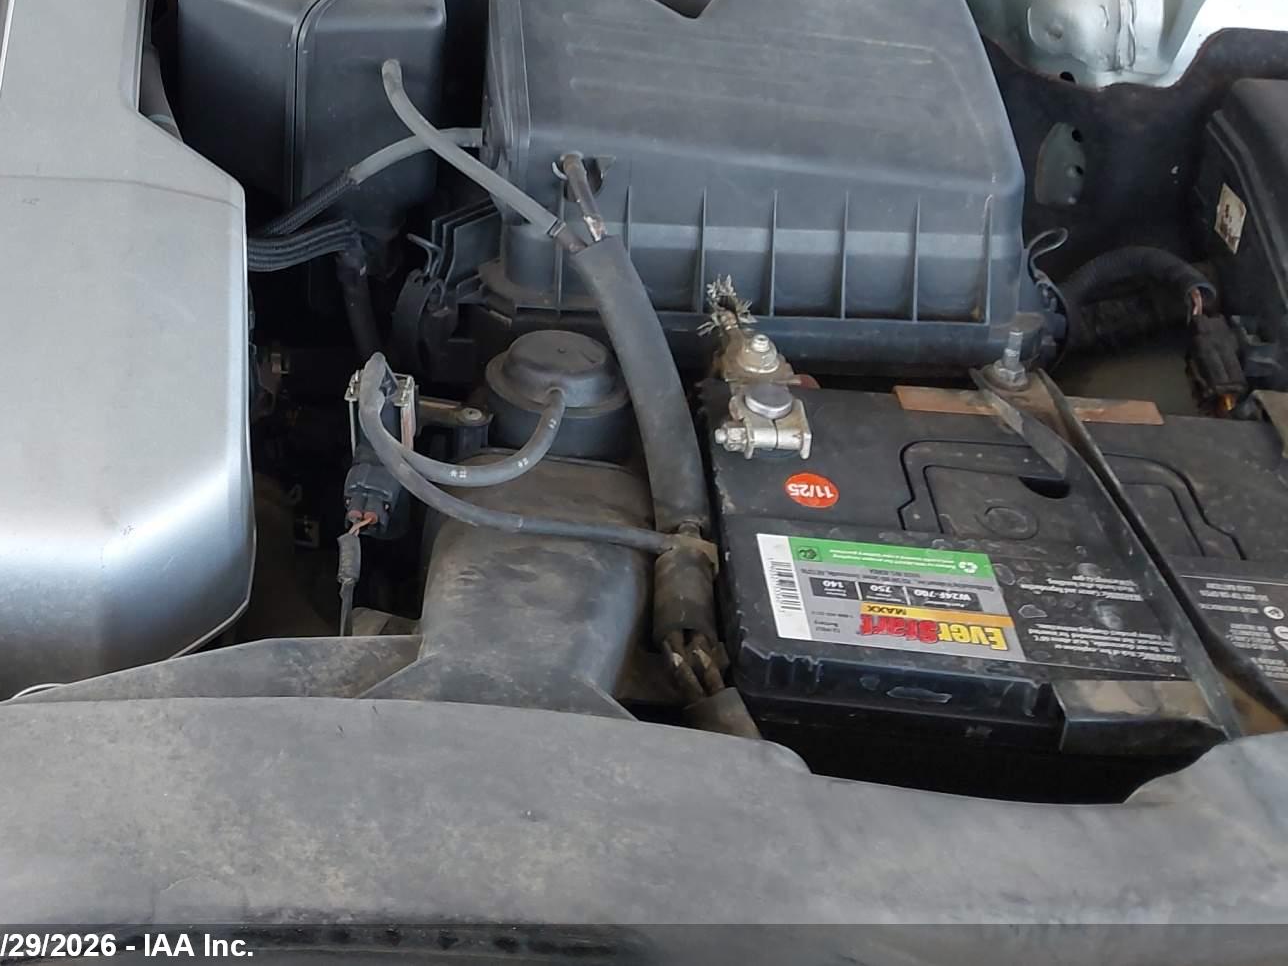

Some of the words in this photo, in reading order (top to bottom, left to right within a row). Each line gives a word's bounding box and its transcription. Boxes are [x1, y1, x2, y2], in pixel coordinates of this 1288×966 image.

[787, 483, 835, 499] 11/25
[867, 605, 908, 617] MAXX
[859, 614, 1009, 651] EverStart
